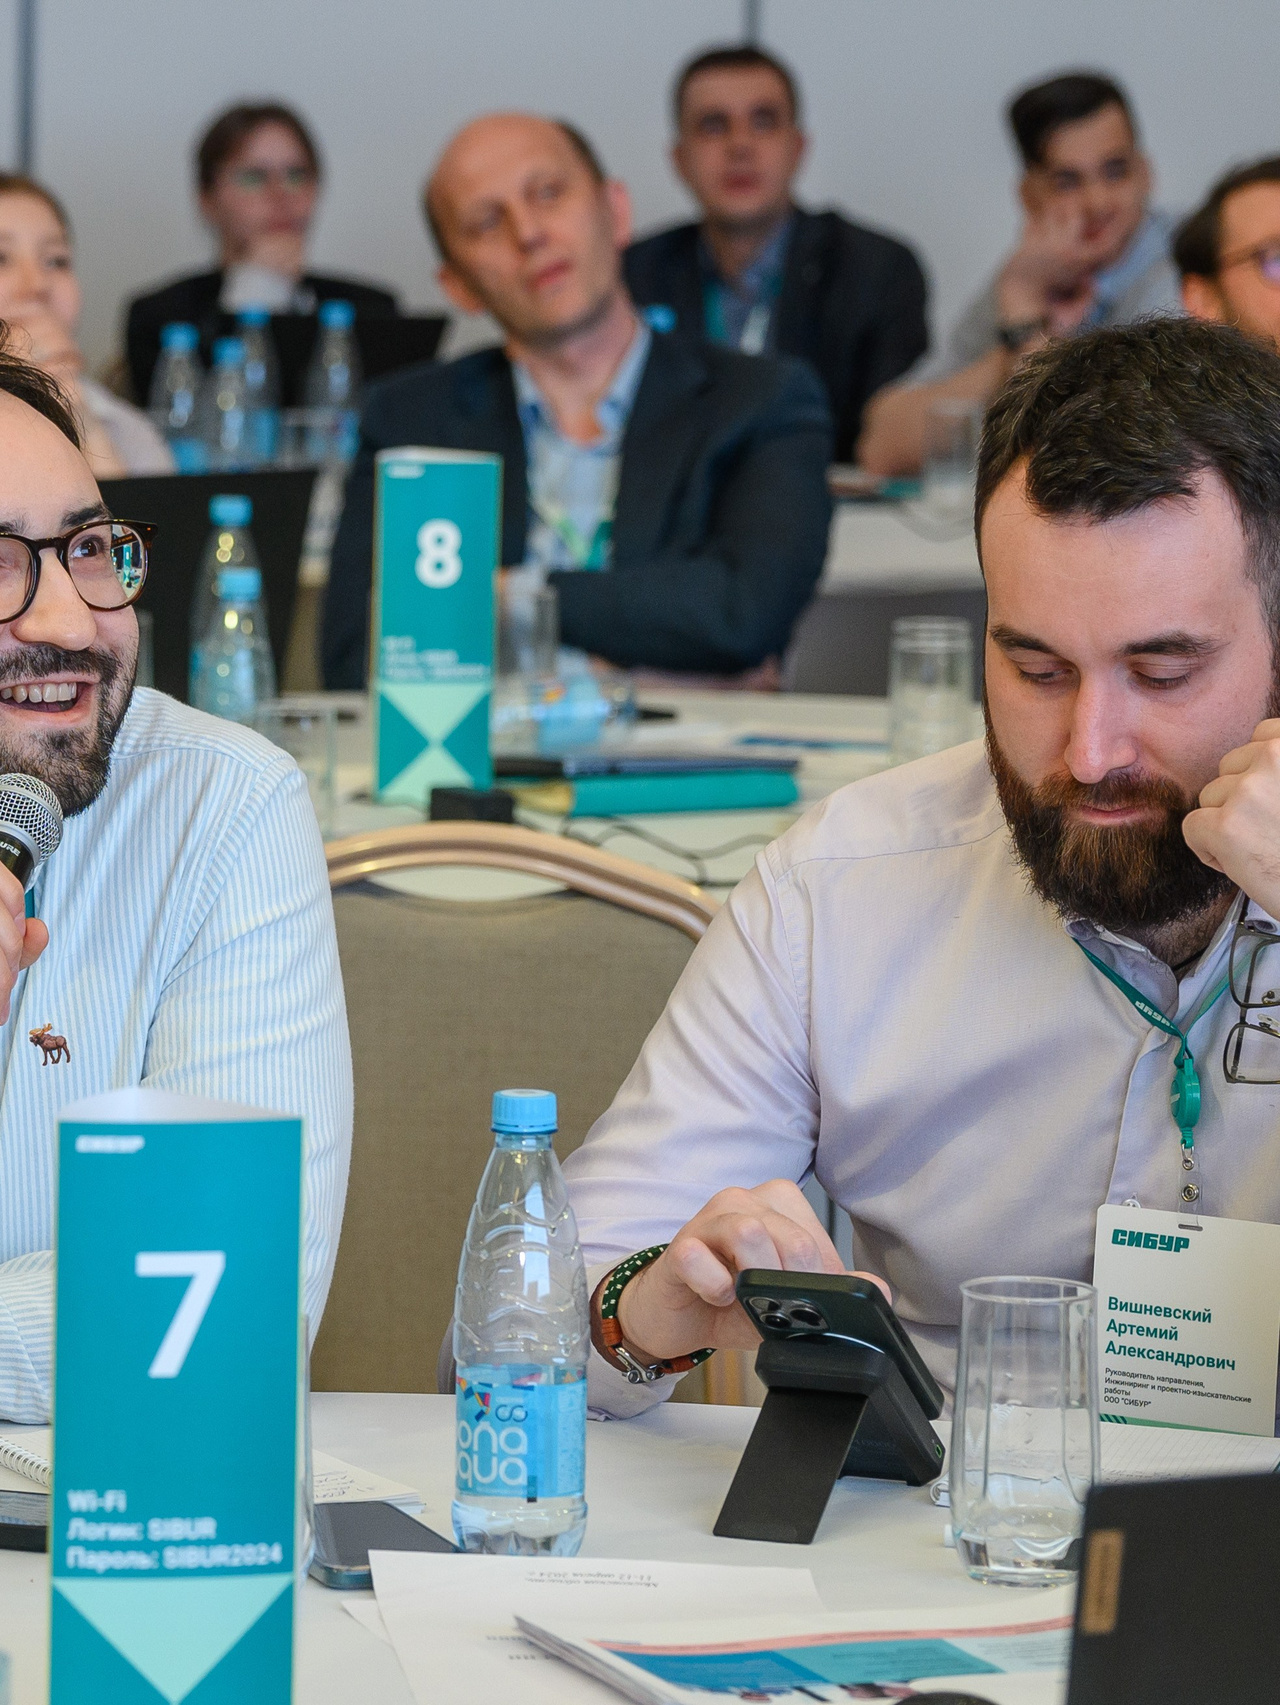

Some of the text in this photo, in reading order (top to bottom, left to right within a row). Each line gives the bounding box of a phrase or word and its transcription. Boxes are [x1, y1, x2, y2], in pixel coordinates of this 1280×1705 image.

[415, 518, 463, 589] 8
[1134, 1000, 1173, 1029] ИБУР
[1111, 1228, 1190, 1253] СИБУР
[135, 1251, 226, 1379] 7
[1108, 1296, 1212, 1324] Вишневский
[1106, 1318, 1179, 1341] Артемий
[1104, 1340, 1236, 1371] Александрович
[1104, 1377, 1149, 1389] Инжиниринг
[1157, 1385, 1252, 1403] проектно-изыскательские
[1105, 1367, 1206, 1388] Руководитель направления,
[1103, 1396, 1120, 1404] ООО
[1104, 1387, 1131, 1396] работы
[458, 1420, 528, 1455] ona
[458, 1451, 528, 1488] qua
[66, 1489, 127, 1513] Wi-Fi
